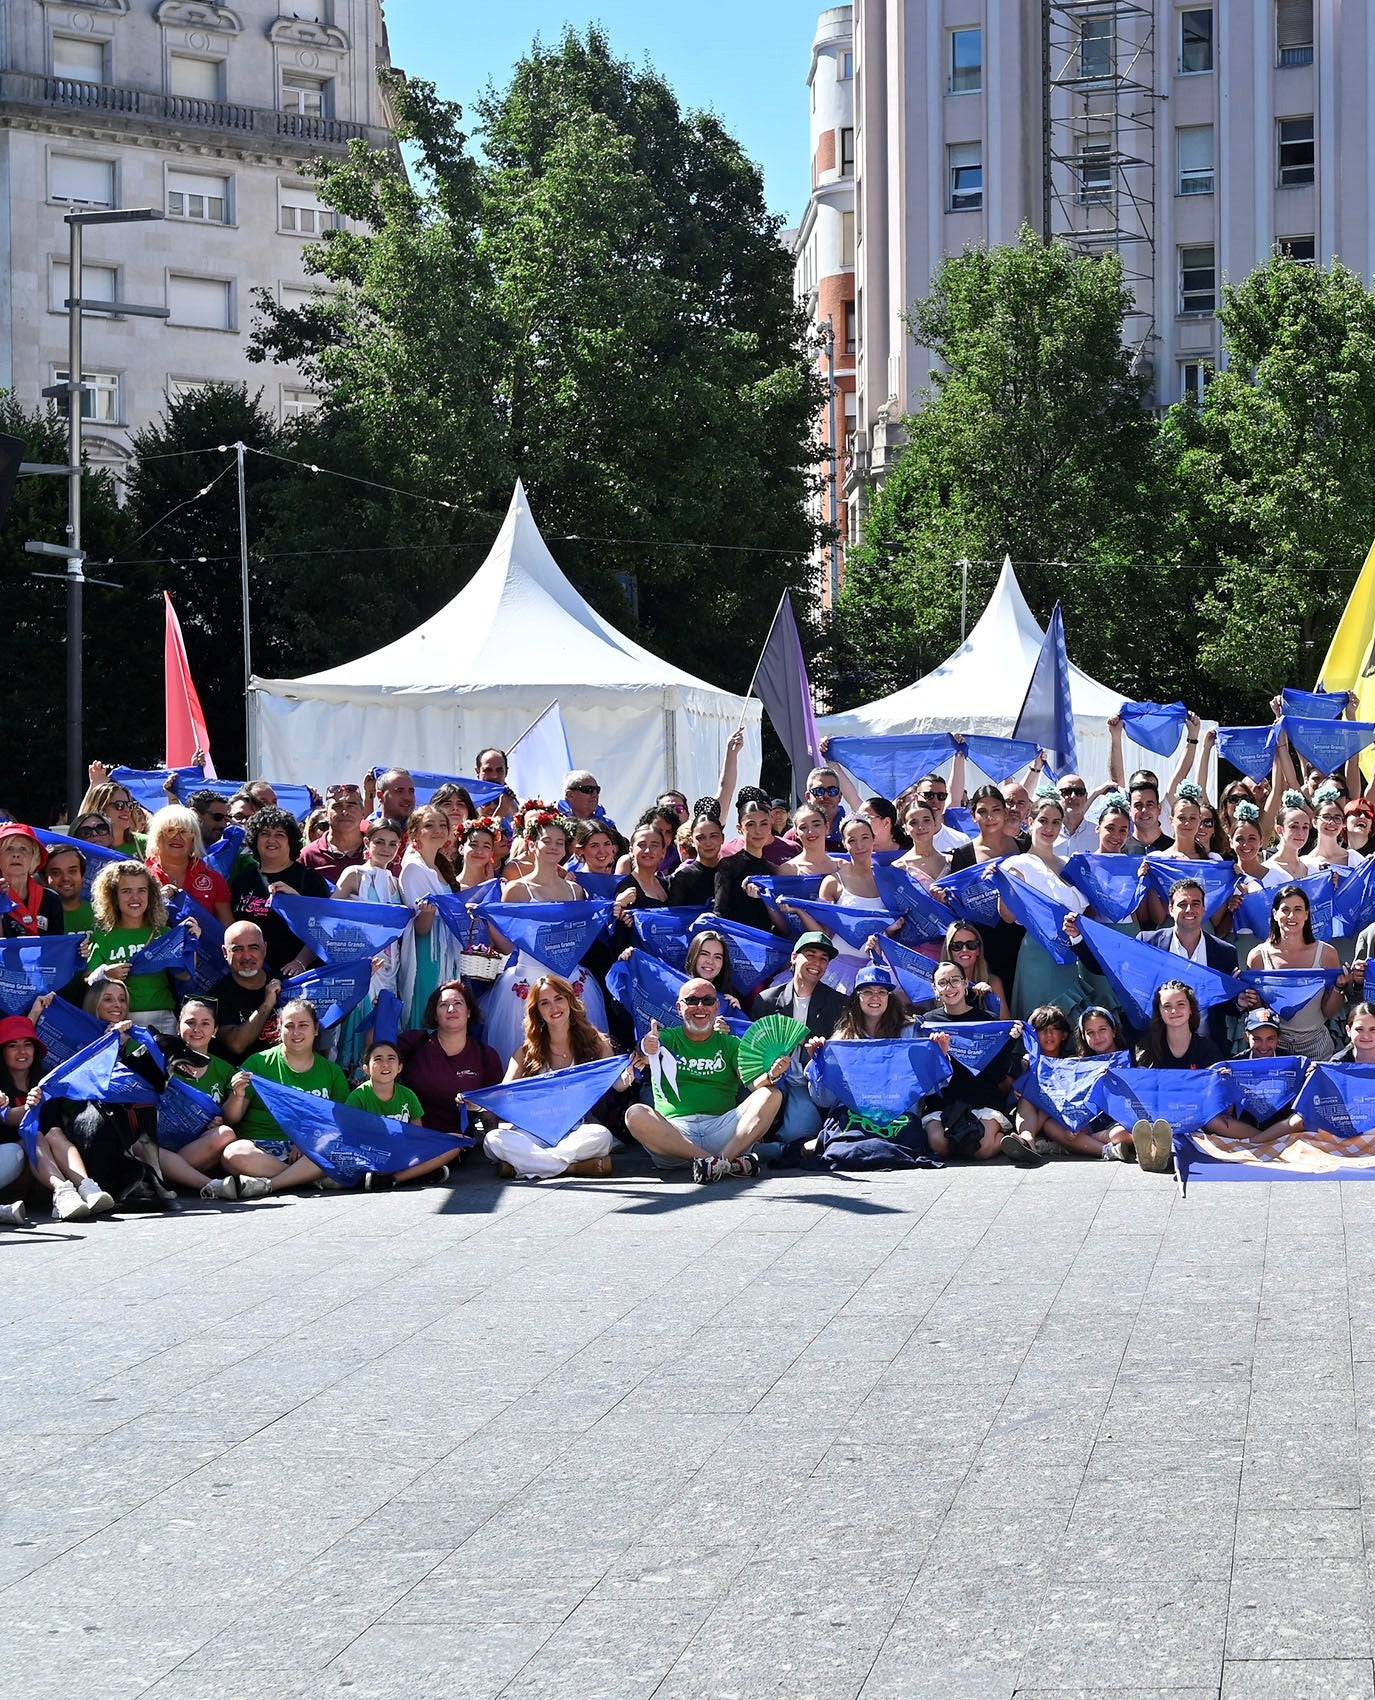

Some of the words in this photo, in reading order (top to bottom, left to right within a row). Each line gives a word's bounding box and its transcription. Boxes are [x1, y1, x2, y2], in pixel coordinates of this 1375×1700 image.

[109, 946, 125, 960] LA
[128, 944, 146, 957] PE
[689, 1056, 724, 1072] PERA
